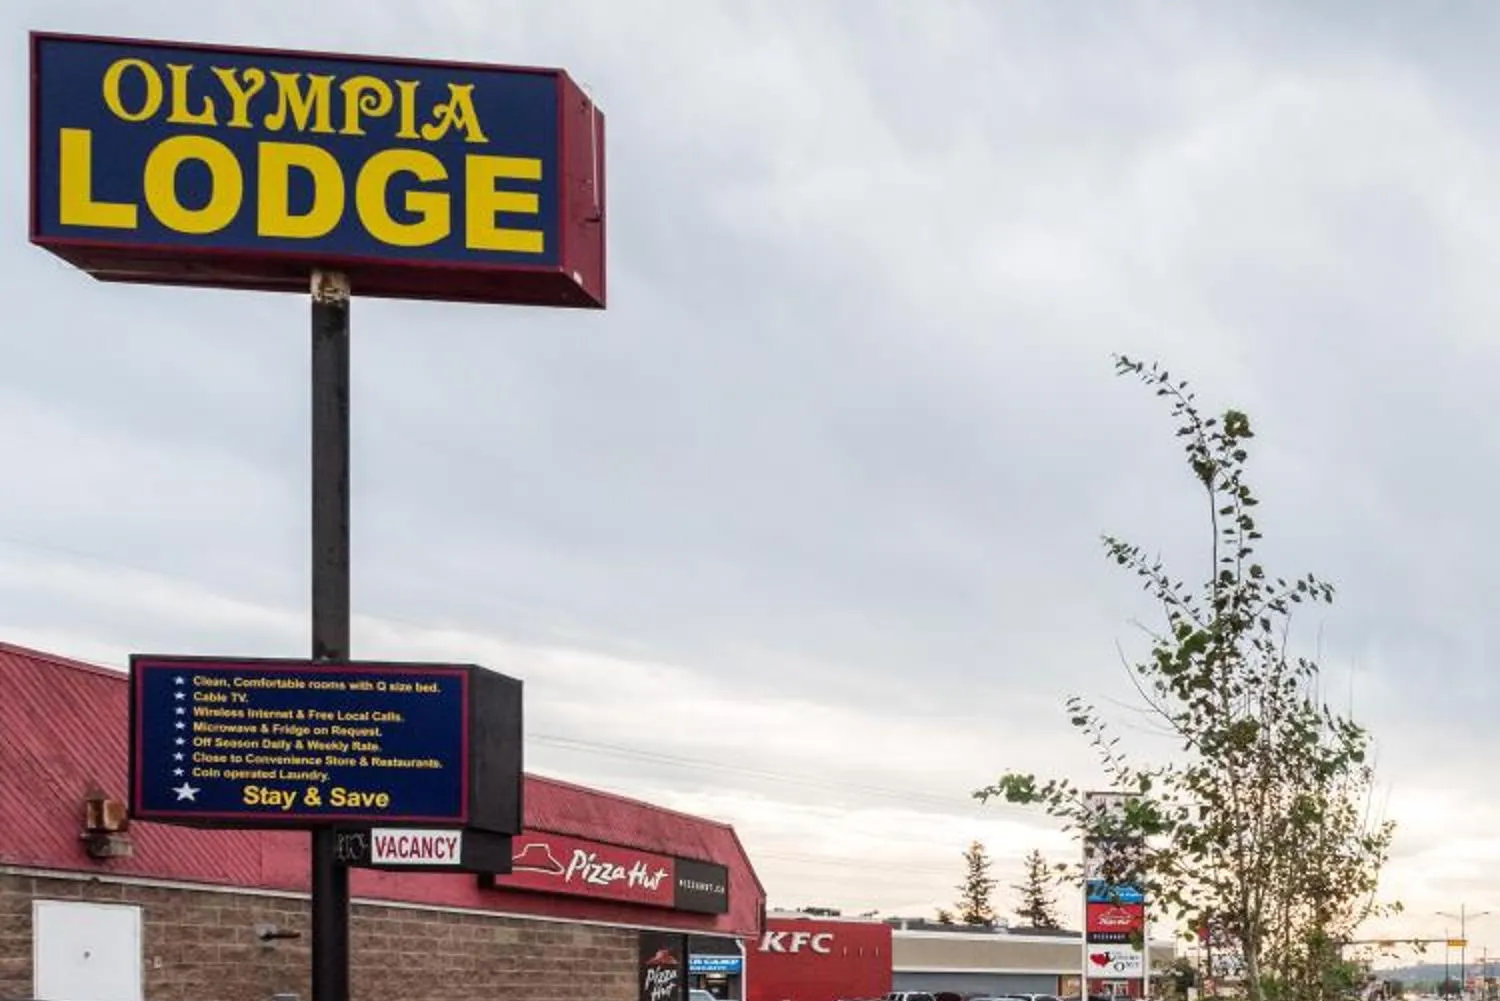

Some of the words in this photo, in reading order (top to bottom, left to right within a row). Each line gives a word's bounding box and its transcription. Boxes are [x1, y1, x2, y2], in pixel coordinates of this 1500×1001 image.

[103, 58, 488, 143] OLYMPIA
[59, 127, 544, 253] LODGE
[234, 677, 306, 689] Comfortable
[308, 681, 346, 690] rooms
[349, 680, 374, 691] with
[376, 681, 387, 692] Q
[389, 682, 412, 692] size
[415, 682, 441, 693] bed.
[193, 691, 228, 702] Cable
[231, 692, 249, 703] TV.
[193, 706, 245, 718] Wireless
[247, 708, 294, 719] Internet
[295, 709, 305, 719] &
[308, 709, 334, 720] Free
[337, 710, 369, 721] Local
[193, 721, 257, 733] Microwave
[260, 723, 269, 733] &
[272, 723, 311, 737] Fridge
[313, 726, 329, 735] on
[331, 725, 383, 738] Request.
[193, 736, 212, 747] Off
[214, 737, 260, 749] Season
[262, 738, 292, 752] Daily
[295, 739, 304, 750] &
[307, 740, 349, 753] Weekly
[192, 751, 227, 763] Close
[230, 752, 243, 763] to
[245, 753, 322, 766] Convenience
[325, 755, 357, 767] Store
[360, 756, 369, 767] &
[192, 767, 221, 778] Coin
[223, 768, 277, 780] operated
[243, 785, 297, 811] Stay
[303, 786, 322, 807] &
[329, 787, 390, 807] Save
[374, 835, 457, 859] VACANCY
[565, 849, 626, 885] Pizza
[627, 860, 668, 891] Hut
[757, 931, 834, 954] KFC
[645, 965, 677, 991] Pizza
